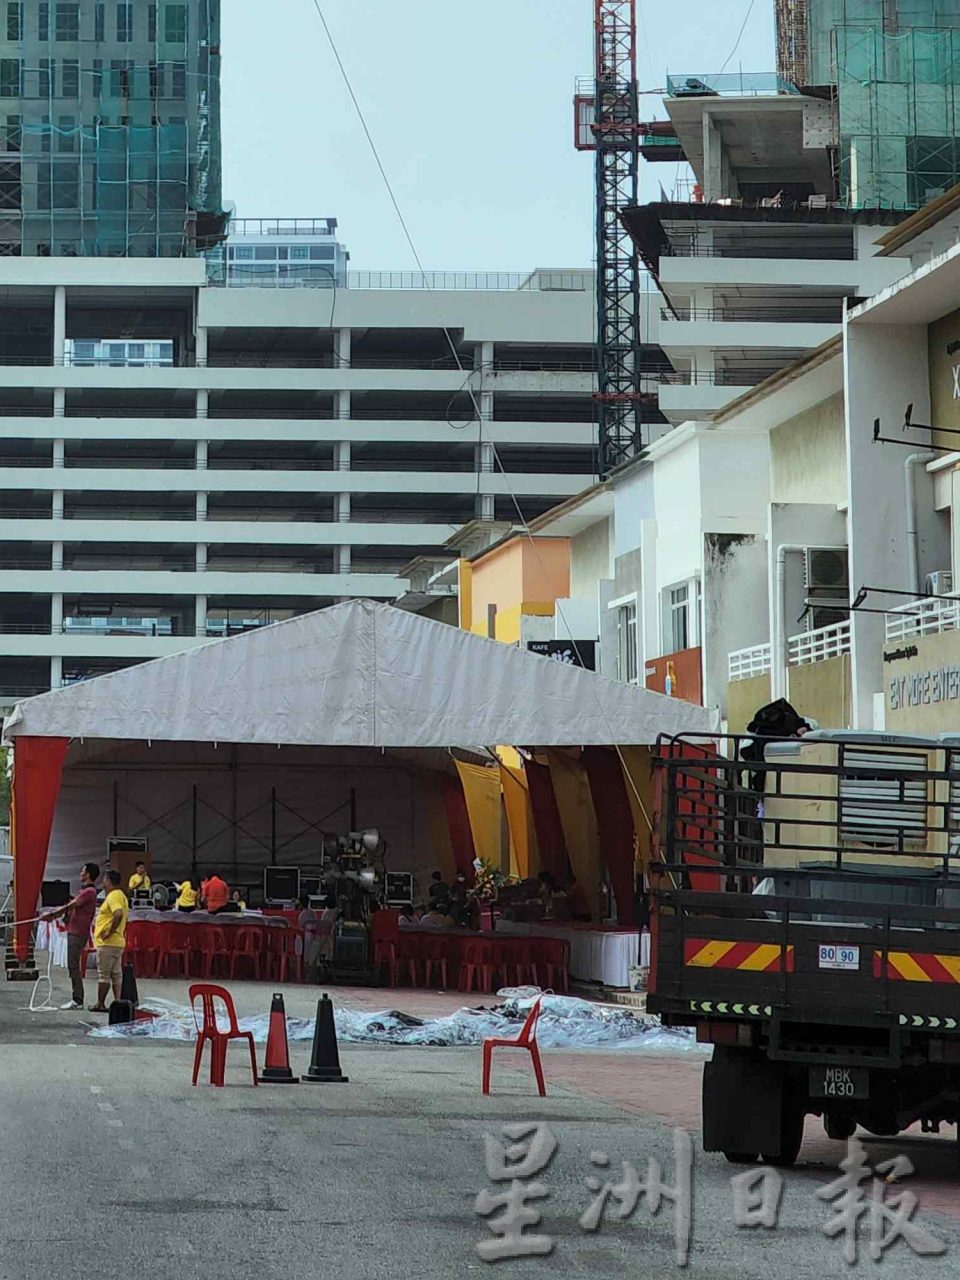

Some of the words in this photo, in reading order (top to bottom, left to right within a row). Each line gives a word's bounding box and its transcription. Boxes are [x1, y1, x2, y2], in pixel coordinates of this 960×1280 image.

[820, 947, 835, 960] 80
[841, 950, 854, 962] 90
[826, 1068, 851, 1082] MBK
[823, 1080, 854, 1096] 1430
